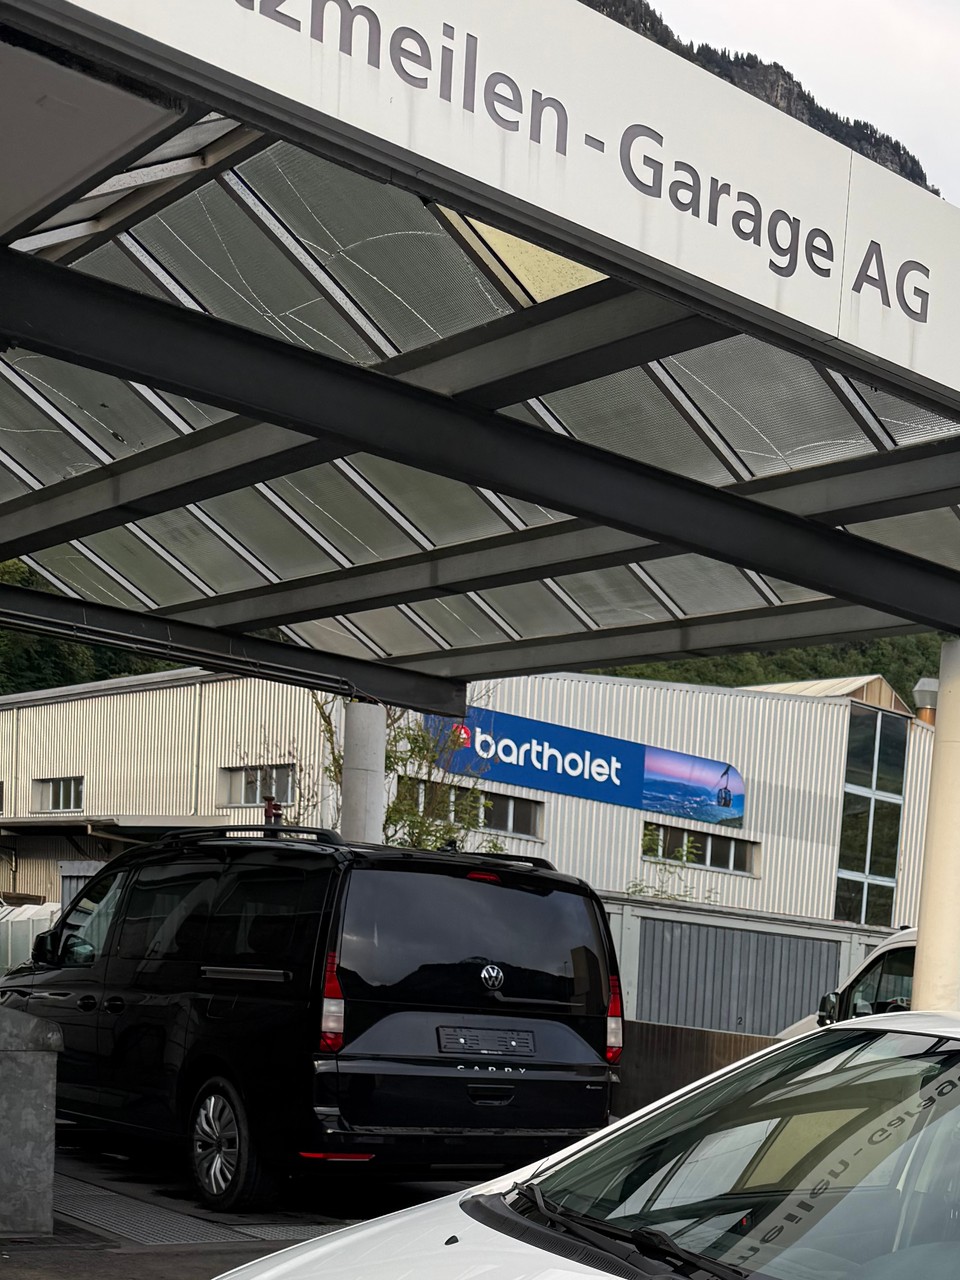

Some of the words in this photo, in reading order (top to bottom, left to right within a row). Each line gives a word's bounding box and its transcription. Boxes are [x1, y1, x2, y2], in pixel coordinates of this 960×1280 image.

[619, 123, 835, 278] Garage
[851, 239, 931, 324] AG
[474, 727, 622, 787] bartholet
[457, 1064, 526, 1075] CADDY
